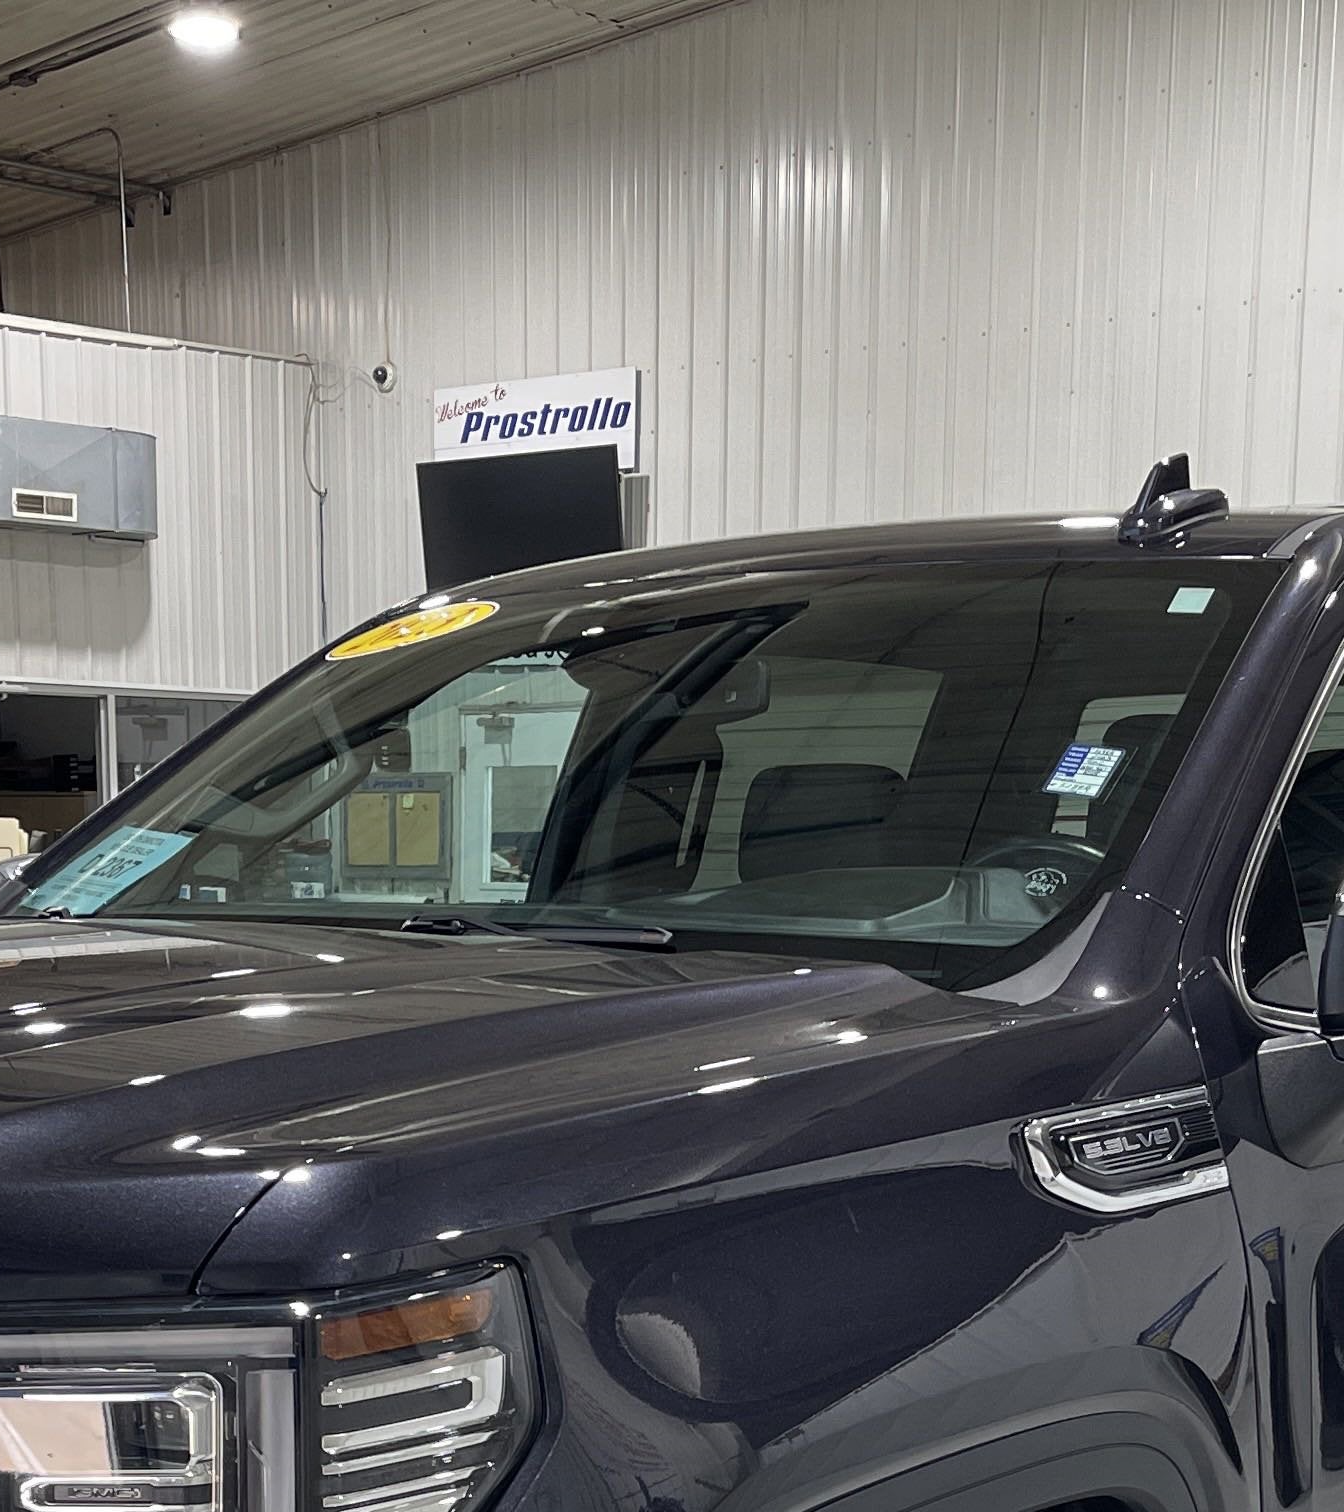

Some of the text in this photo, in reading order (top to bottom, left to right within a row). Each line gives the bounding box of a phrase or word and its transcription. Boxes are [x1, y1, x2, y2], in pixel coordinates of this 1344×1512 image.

[435, 384, 507, 424] Welcome to
[460, 397, 631, 444] Prostrollo
